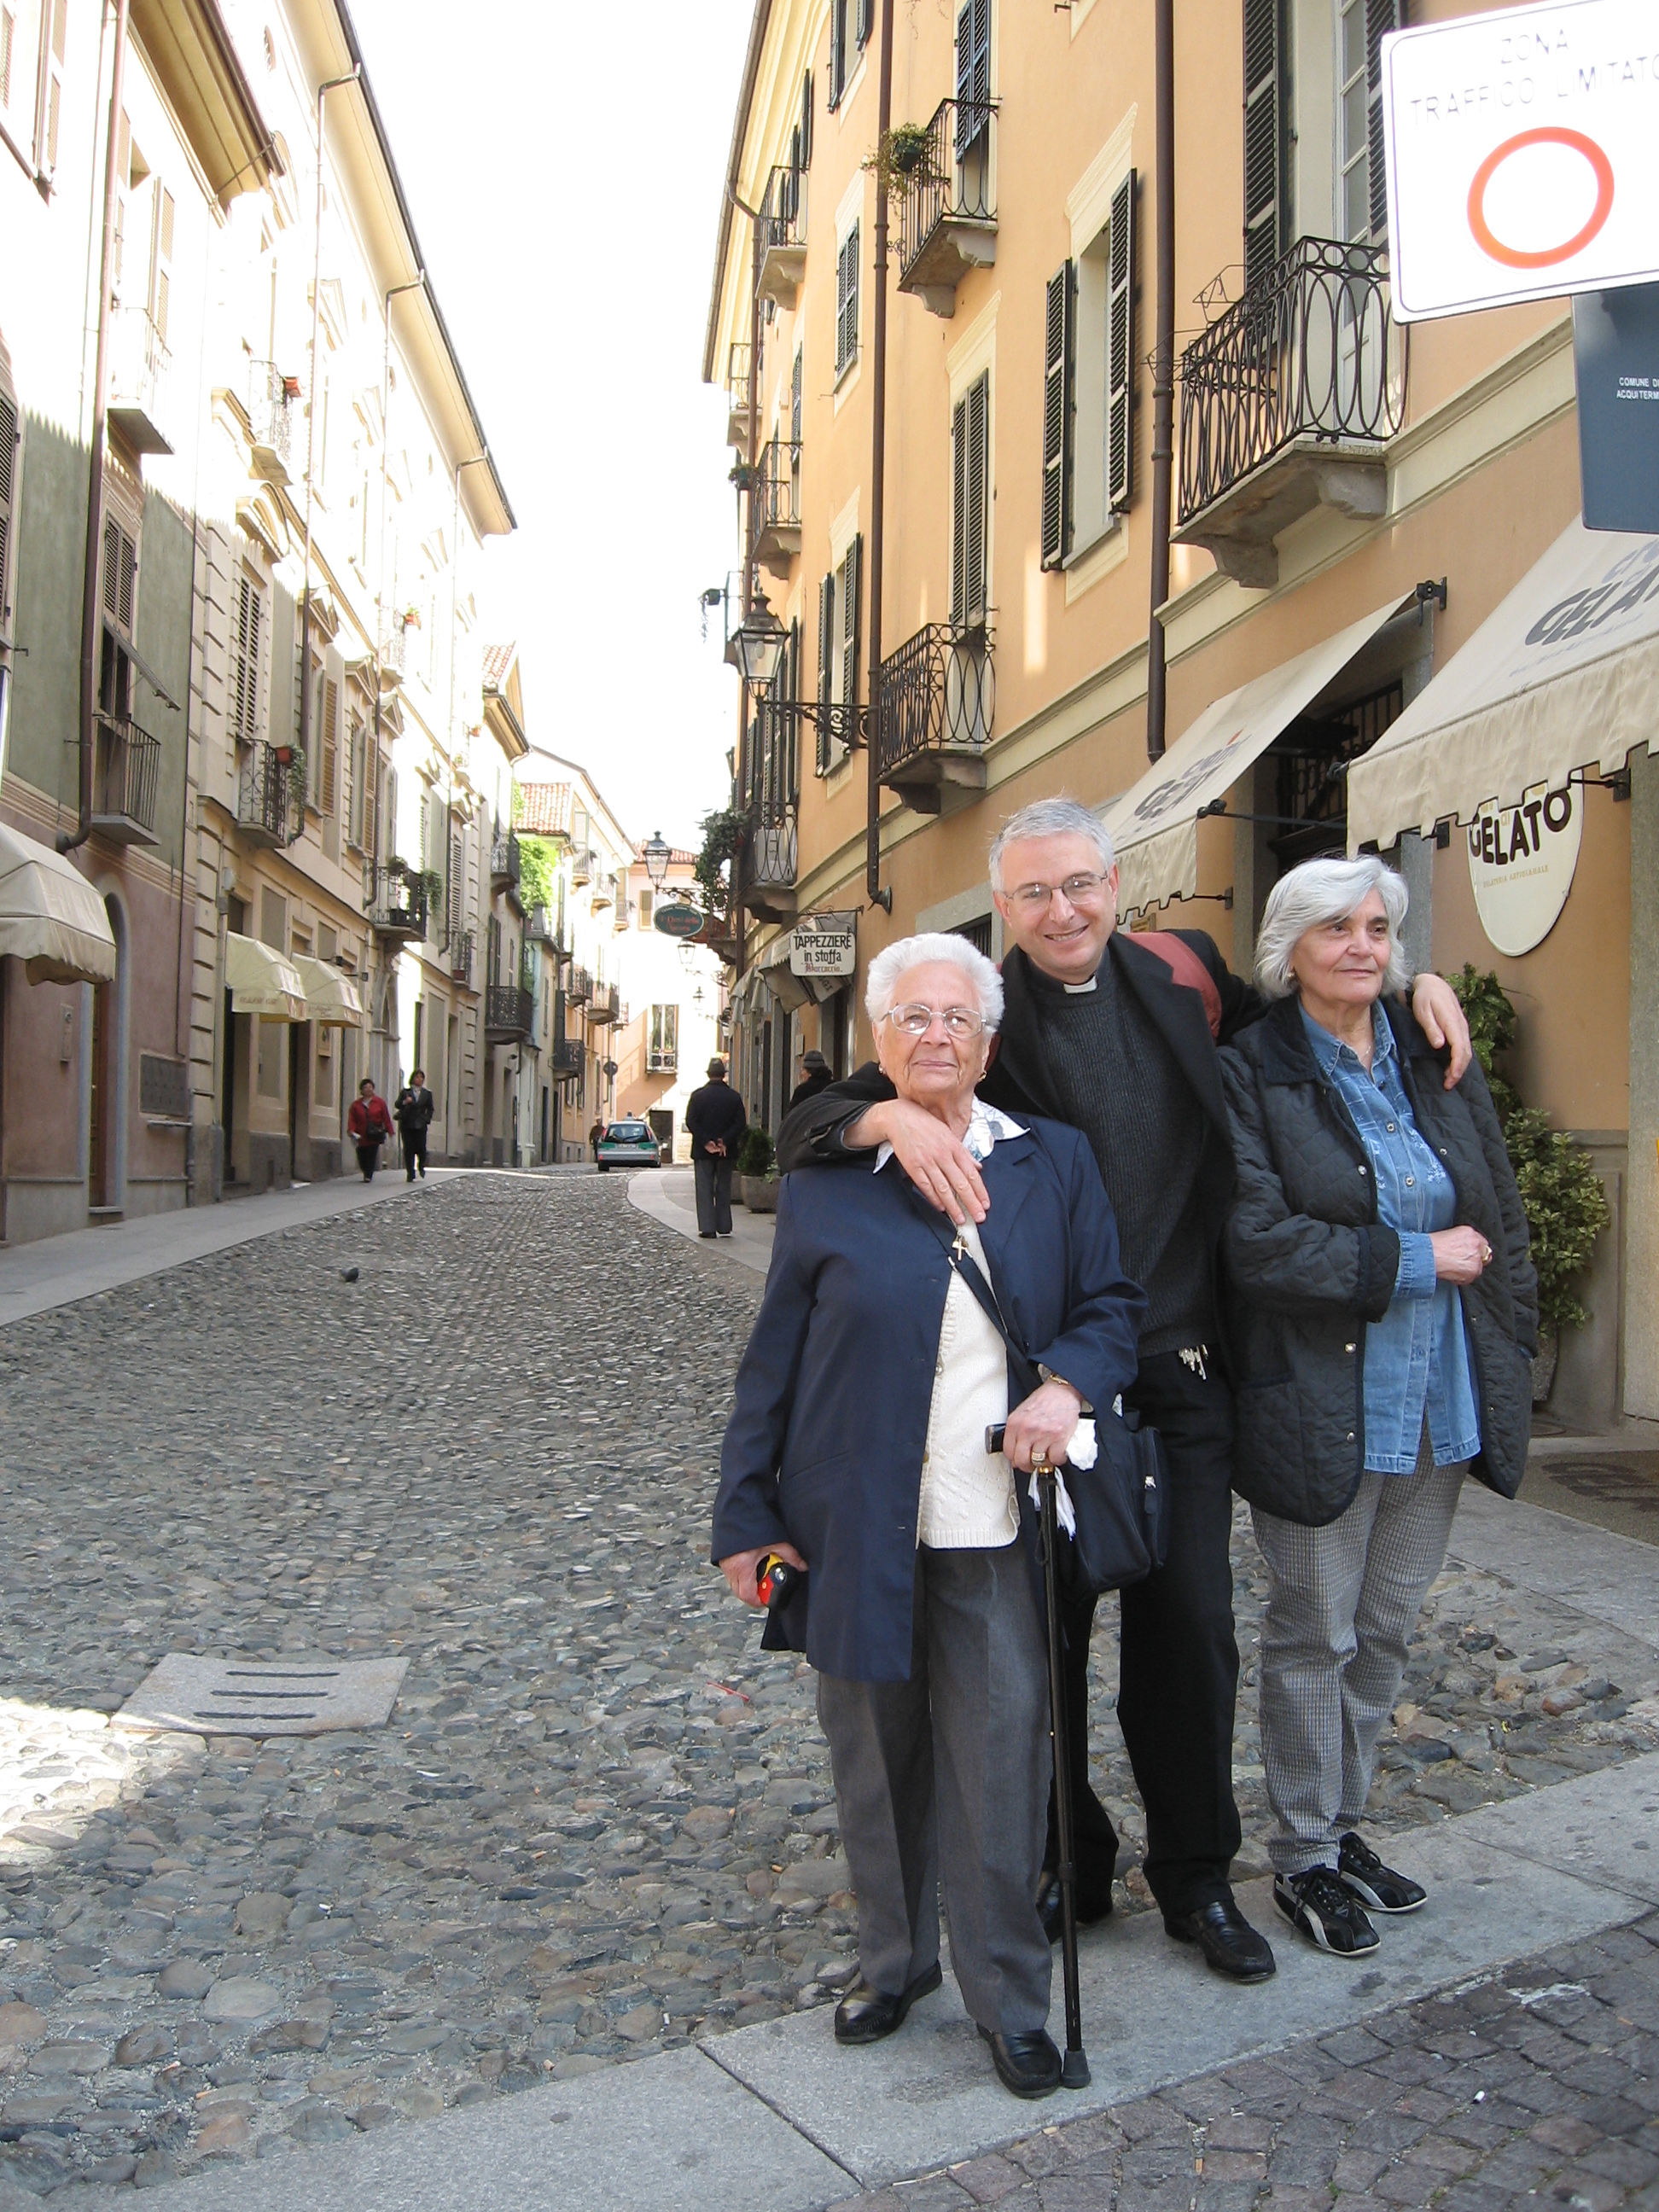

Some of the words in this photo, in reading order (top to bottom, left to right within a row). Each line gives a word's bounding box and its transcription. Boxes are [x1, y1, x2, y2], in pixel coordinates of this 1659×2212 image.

[1501, 29, 1569, 64] ZONA
[1410, 77, 1535, 125] TRAFFICO
[1619, 377, 1649, 387] COMUNE
[1524, 564, 1659, 646] GELA
[1469, 789, 1572, 865] GELATO
[793, 935, 852, 950] TAPPEZZIERE
[804, 950, 812, 963] in
[815, 949, 841, 964] stoffa
